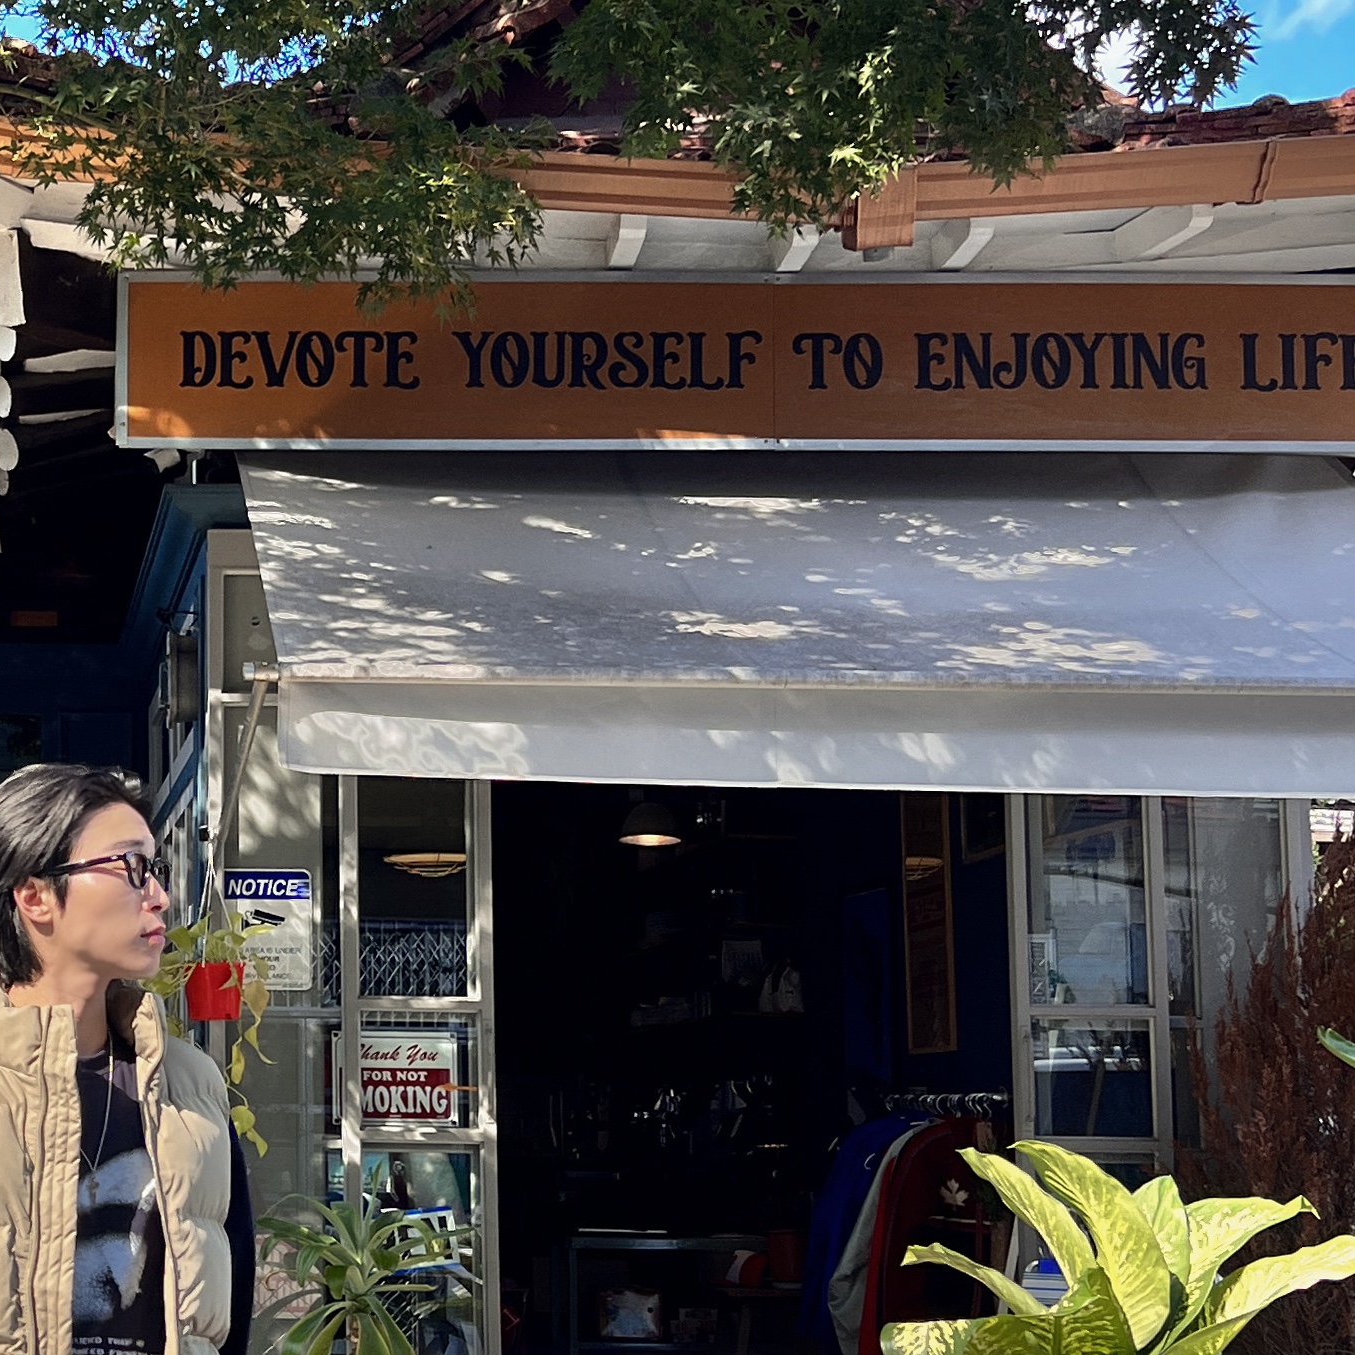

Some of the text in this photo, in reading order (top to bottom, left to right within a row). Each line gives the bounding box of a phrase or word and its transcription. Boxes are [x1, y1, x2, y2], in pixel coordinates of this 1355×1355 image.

[179, 330, 420, 390] DEVOTE
[451, 330, 763, 392] YOURSELF
[792, 331, 884, 391] TO
[913, 331, 1208, 391] ENJOYING
[228, 878, 300, 896] NOTICE
[406, 1044, 438, 1066] You
[363, 1070, 428, 1082] FOR NOT
[360, 1084, 448, 1114] MOKING
